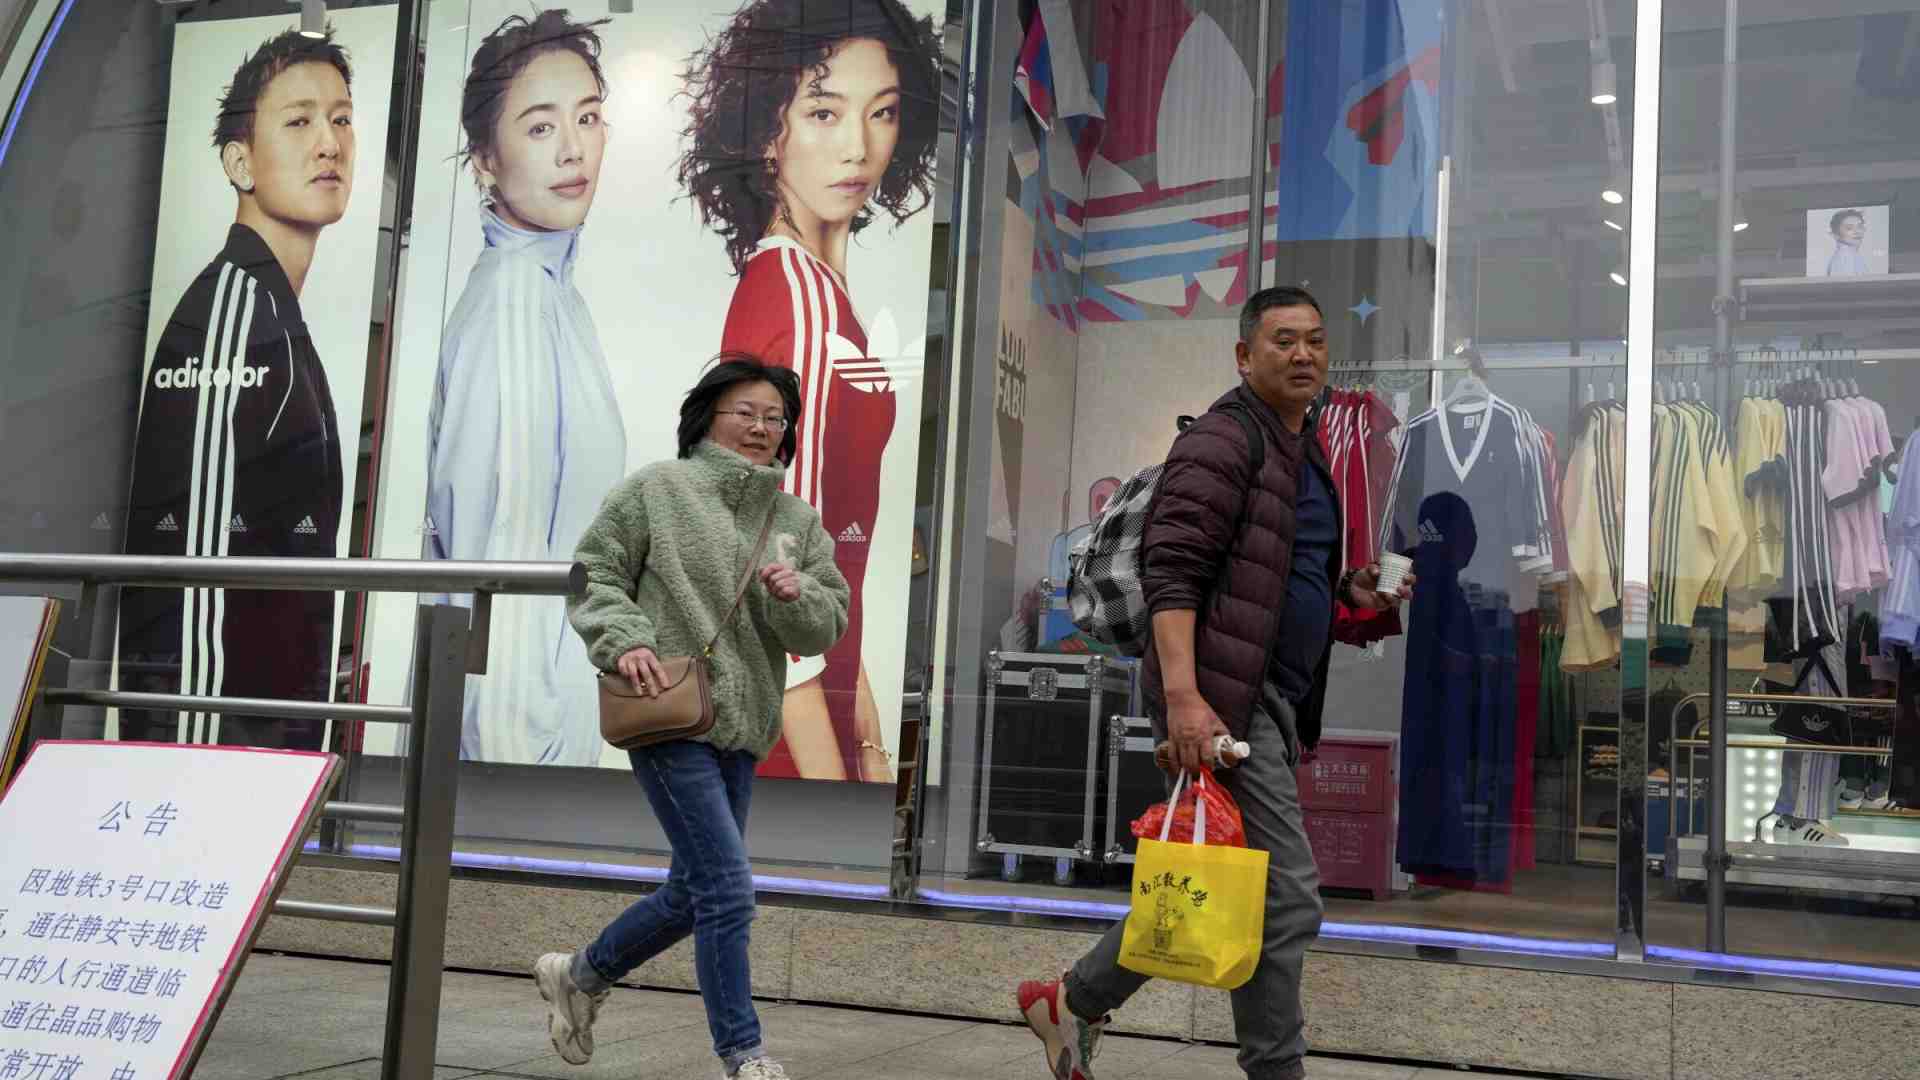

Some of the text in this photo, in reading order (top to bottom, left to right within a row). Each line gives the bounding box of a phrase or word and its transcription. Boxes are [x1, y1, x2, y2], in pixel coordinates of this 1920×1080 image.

[154, 357, 270, 389] adicolor
[98, 799, 179, 837] 公告
[19, 868, 229, 910] 因地铁3号口改造
[0, 908, 208, 953] ，通往静安寺地铁
[1, 1000, 162, 1045] 通往晶品购物
[0, 1048, 84, 1080] 常开放
